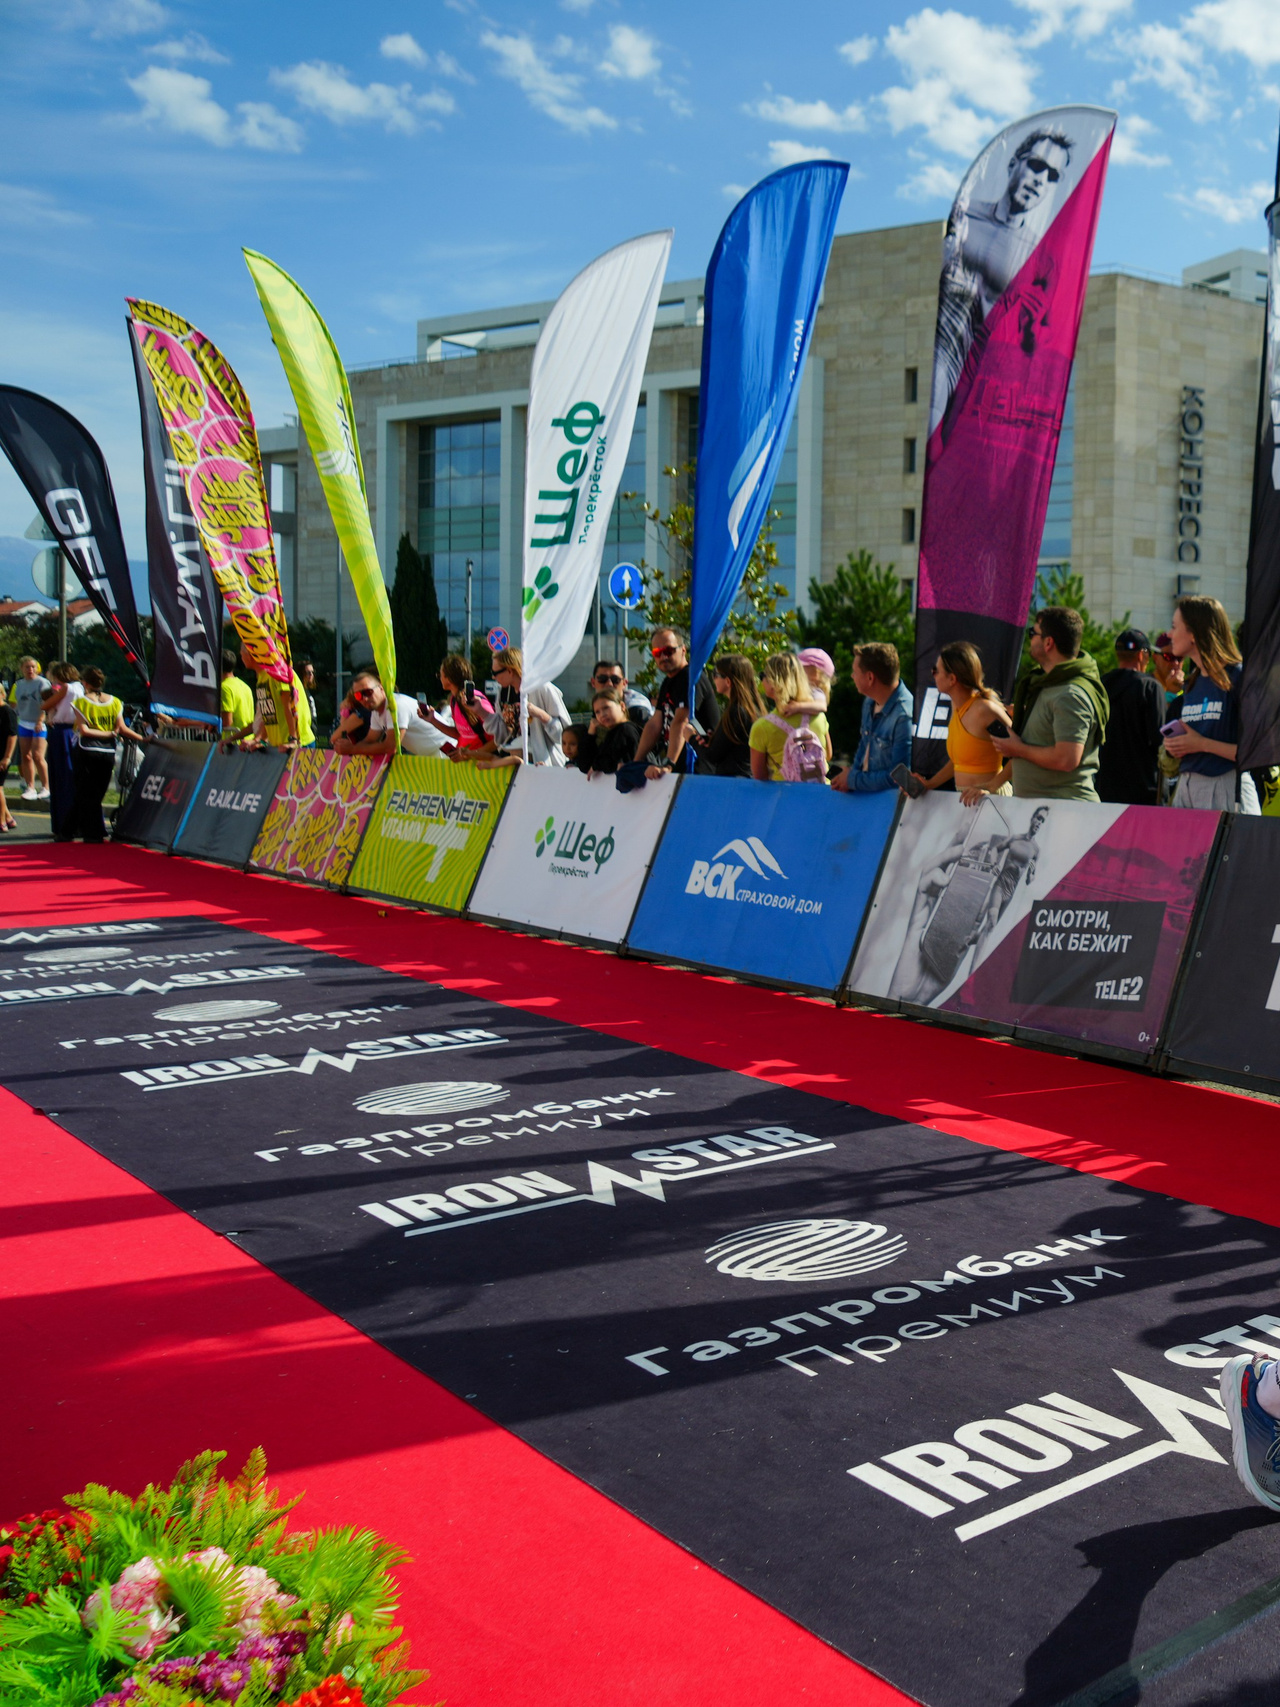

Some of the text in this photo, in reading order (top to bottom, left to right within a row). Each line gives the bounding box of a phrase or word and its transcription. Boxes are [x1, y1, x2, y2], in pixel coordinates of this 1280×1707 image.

[530, 401, 606, 549] Шеф
[1177, 385, 1206, 563] КОНГРЕСС
[386, 790, 490, 826] FAHRENHEIT
[554, 820, 616, 874] Шеф
[685, 859, 824, 916] ВСК СТРАХОВОЙ ДОМ
[1028, 932, 1133, 954] КАК БЕЖИТ
[1034, 909, 1112, 932] СМОТРИ,
[0, 964, 301, 1001] RON STAR
[1095, 976, 1144, 1002] TELE2
[58, 1004, 412, 1050] Газпромбанк
[138, 1016, 383, 1050] Премиум
[119, 1028, 500, 1087] IRON STAR
[253, 1087, 677, 1163] Газпромбанк
[357, 1107, 651, 1164] Премиум
[358, 1126, 822, 1228] IRON STAR
[624, 1227, 1128, 1378] Газпромбанк
[775, 1265, 1127, 1377] Премиум
[846, 1391, 1143, 1519] IRON
